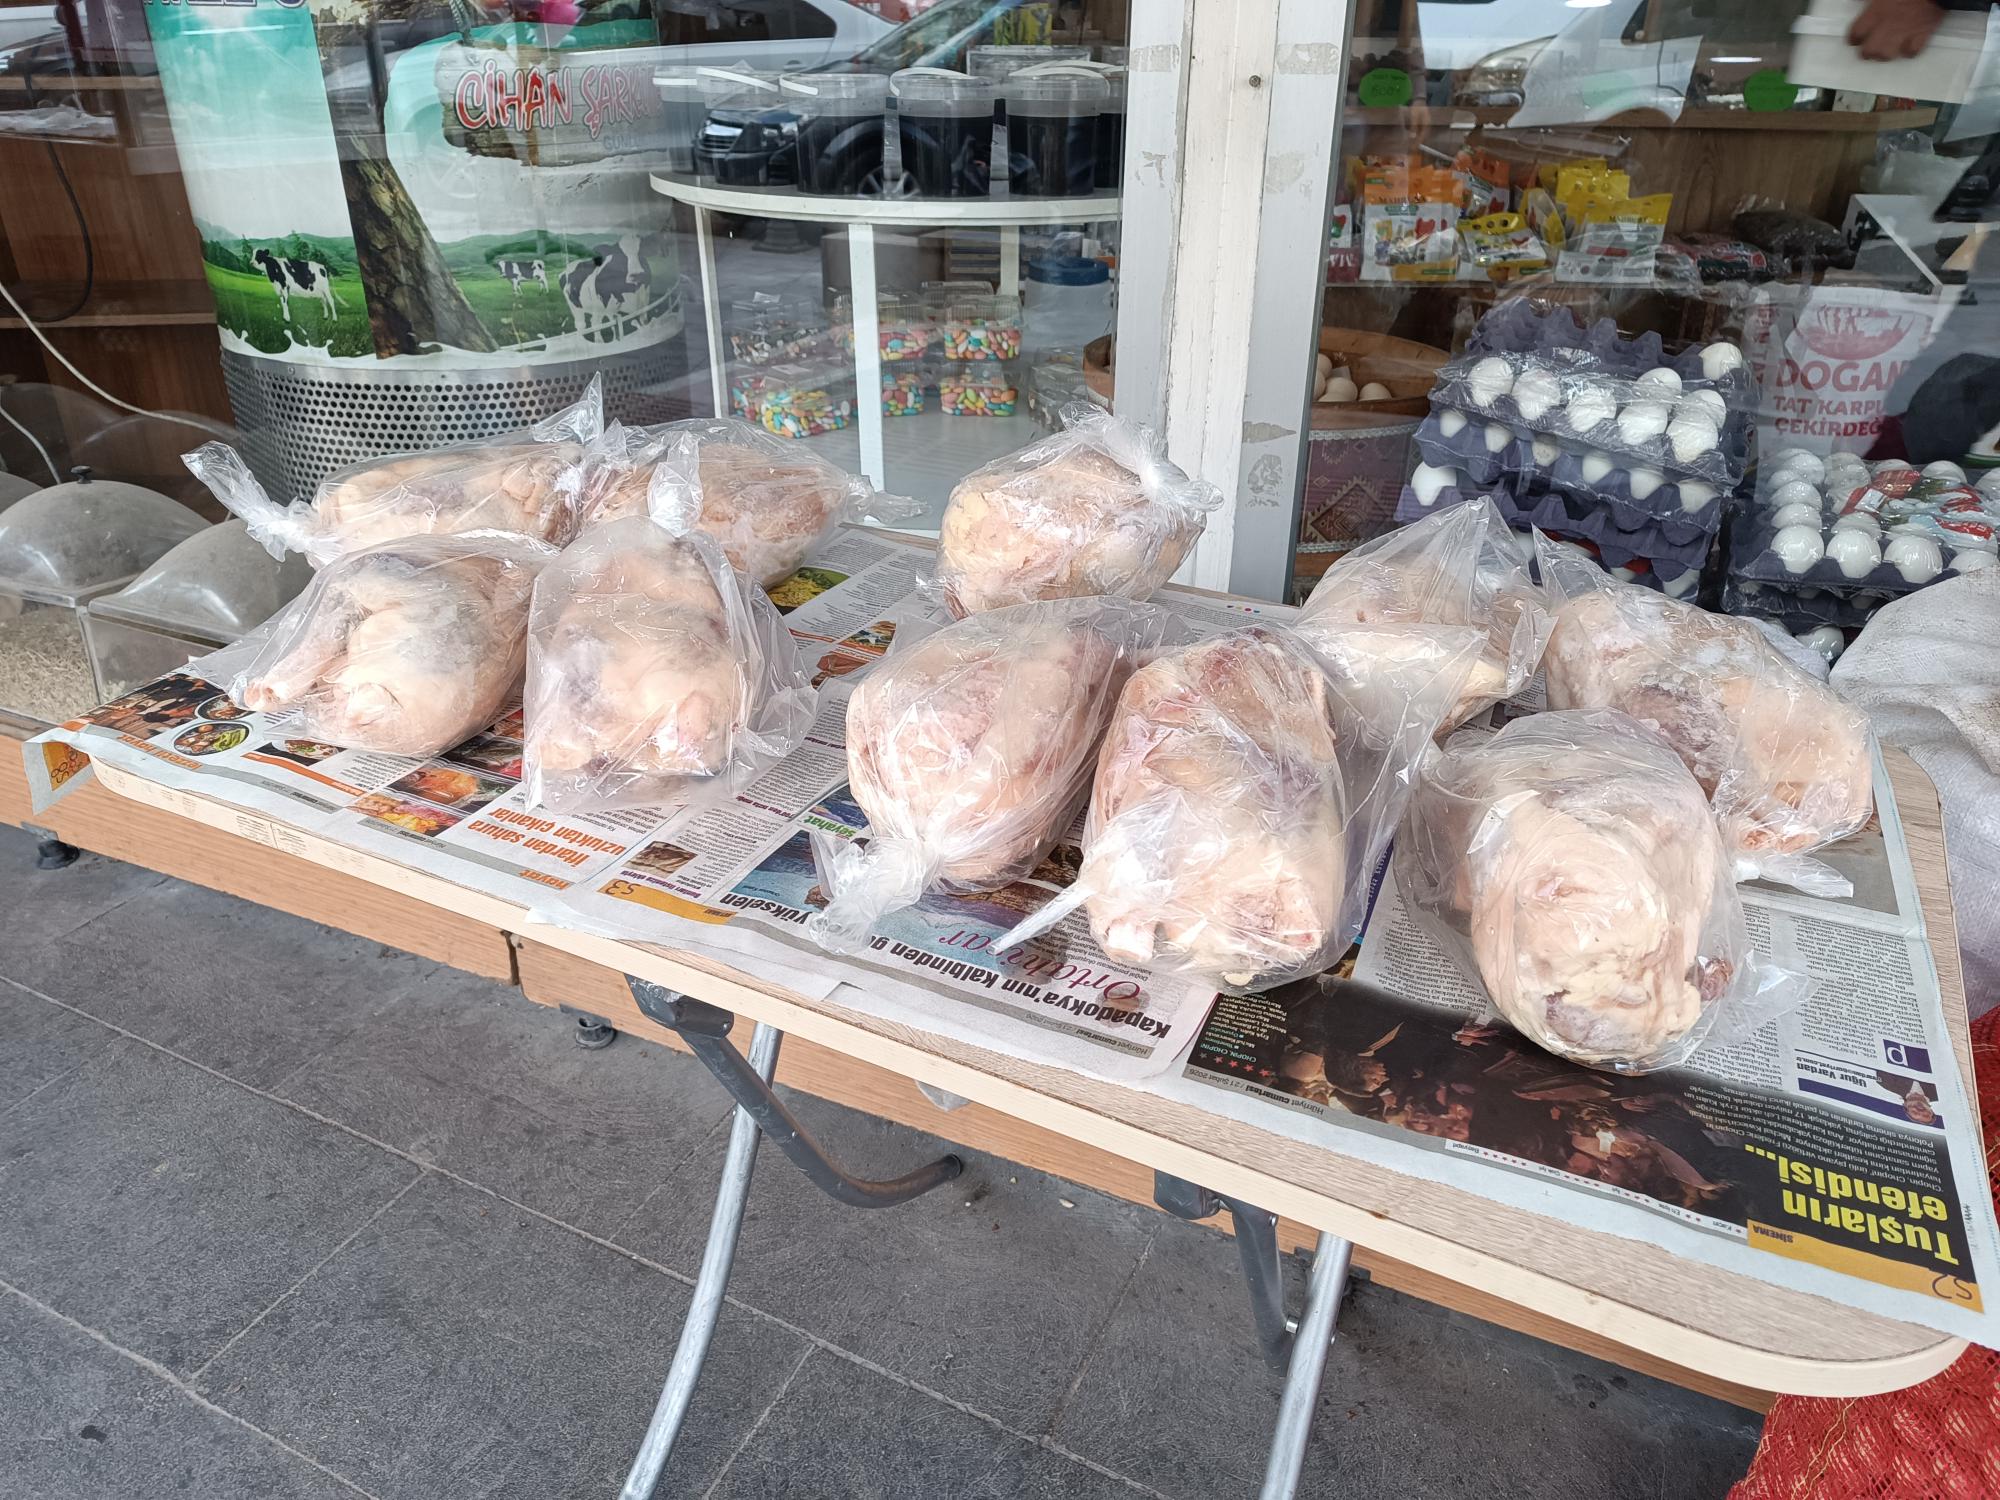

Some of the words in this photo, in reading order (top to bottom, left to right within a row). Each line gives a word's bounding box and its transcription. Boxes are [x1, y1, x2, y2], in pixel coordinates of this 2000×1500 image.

[456, 59, 573, 131] CİHAN
[1773, 396, 1812, 413] TAT
[1817, 400, 1886, 416] KARPU
[1774, 417, 1882, 438] ÇEKİRDEĞ
[466, 816, 526, 849] sahura
[486, 802, 556, 839] çıkanlar
[802, 813, 856, 840] seyahat
[552, 823, 627, 859] uzluktan
[517, 866, 570, 893] hayat
[716, 890, 814, 928] yükselen
[889, 943, 1000, 989] kalbinden
[939, 926, 1143, 1001] Ortahiar
[1000, 978, 1173, 1041] Kapadokya'nın
[1796, 1062, 1836, 1078] Vardan
[1839, 1073, 1866, 1087] Uğur
[1244, 1083, 1290, 1104] cumartesi
[1290, 1097, 1324, 1115] Hürriyet
[1818, 1108, 1828, 1116] en
[1830, 1114, 1863, 1126] tarihinin
[1865, 1124, 1896, 1136] sinema
[1826, 1130, 1843, 1140] Ana
[1898, 1133, 1933, 1146] Polonya
[1816, 1152, 1846, 1165] piyano
[1911, 1161, 1938, 1173] yapım
[1745, 1143, 1949, 1222] efendisi...
[1783, 1189, 1962, 1268] Tuşların
[1929, 1270, 1973, 1304] S2
